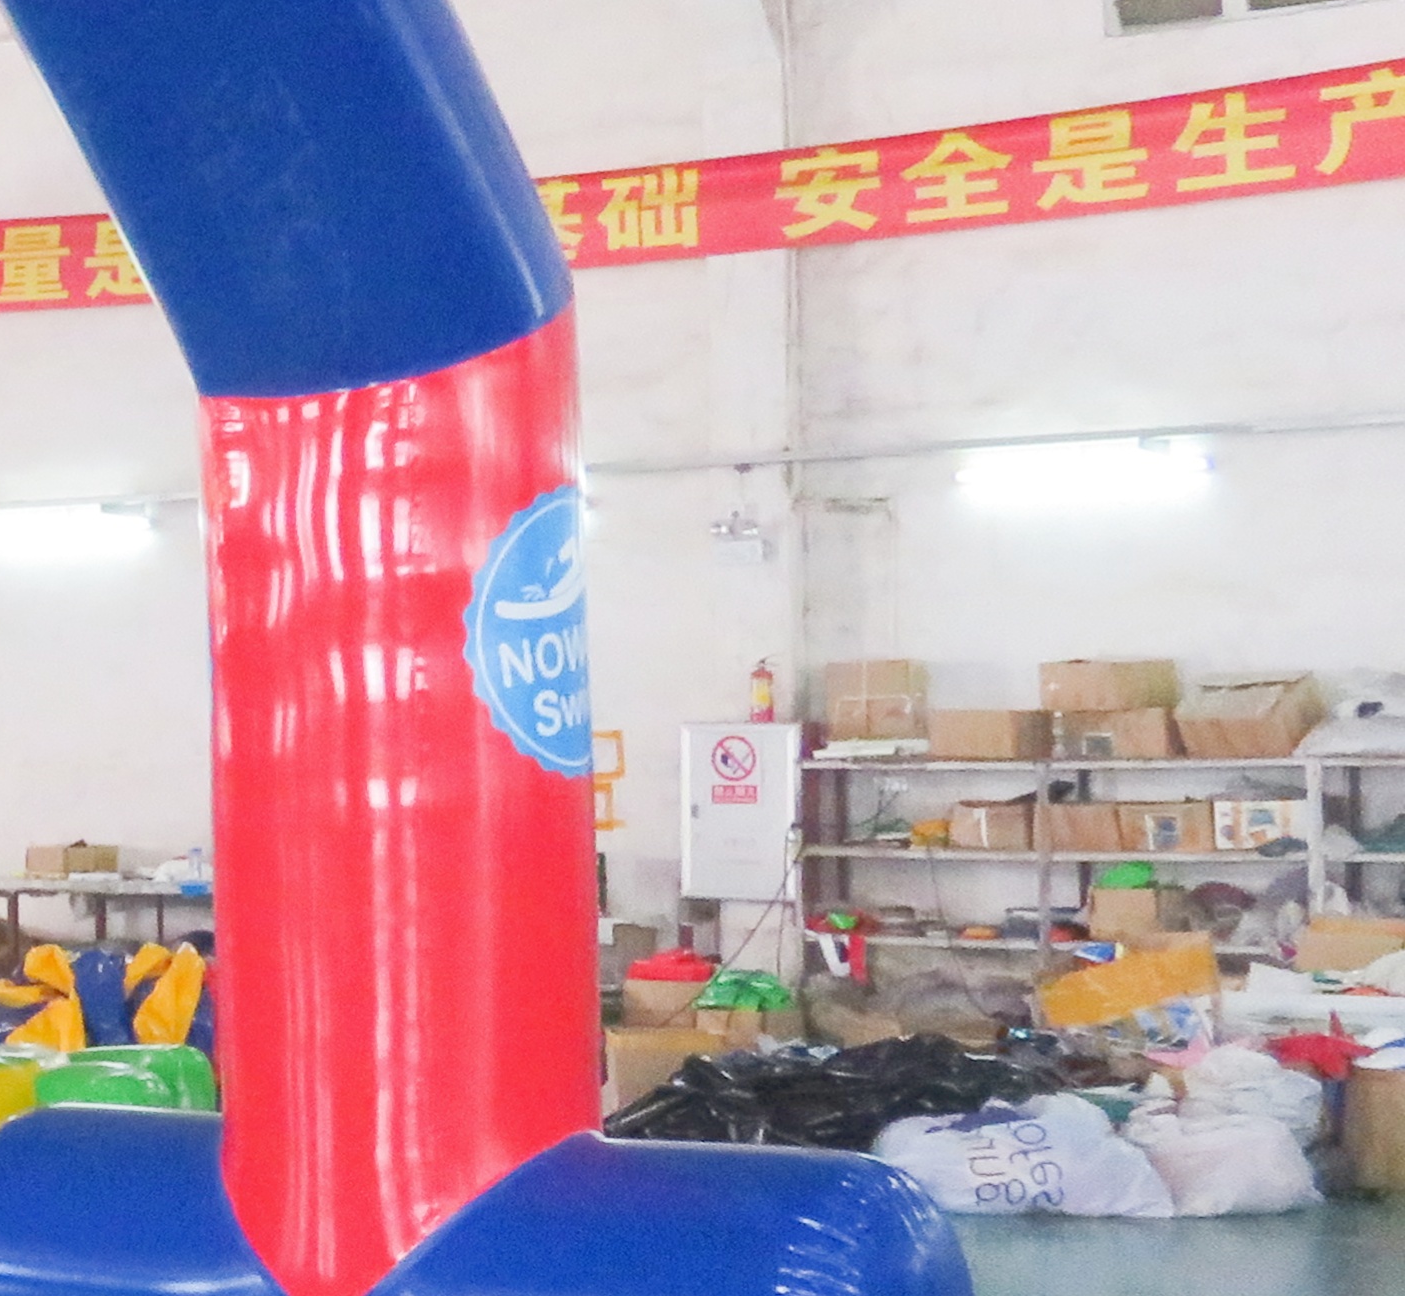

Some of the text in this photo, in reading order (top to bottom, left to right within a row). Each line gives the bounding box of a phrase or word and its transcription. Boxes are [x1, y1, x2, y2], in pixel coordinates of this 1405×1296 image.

[775, 68, 1405, 239] 安全是生产
